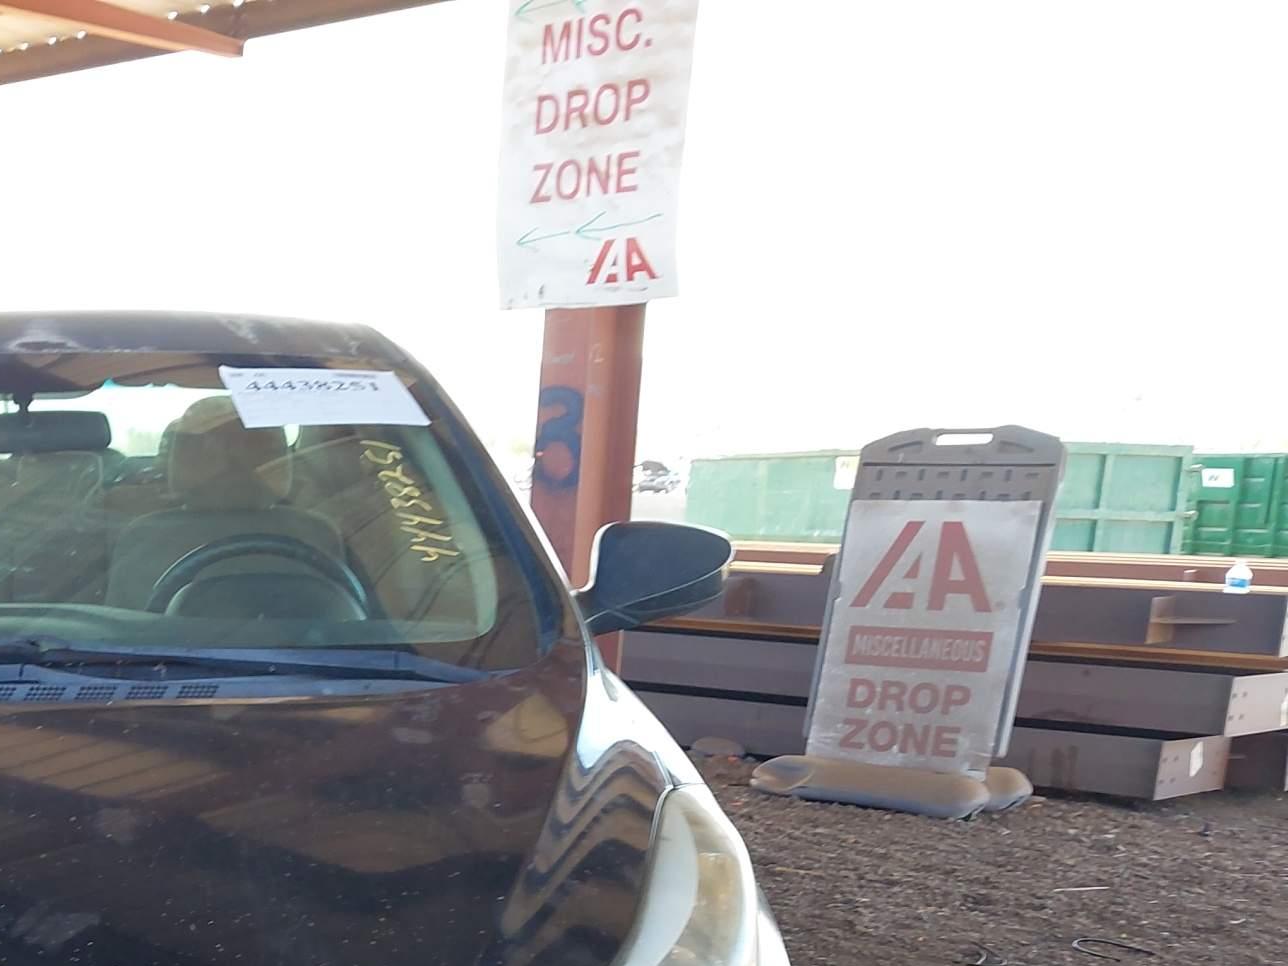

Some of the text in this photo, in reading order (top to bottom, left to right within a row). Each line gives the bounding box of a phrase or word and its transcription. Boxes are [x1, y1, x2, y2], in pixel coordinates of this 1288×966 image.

[541, 8, 653, 65] MISC.
[535, 78, 651, 136] DROP
[529, 150, 641, 204] ZONE
[852, 632, 986, 663] MISCELLANEOUS
[845, 677, 972, 716] DROP
[838, 717, 962, 758] ZONE
